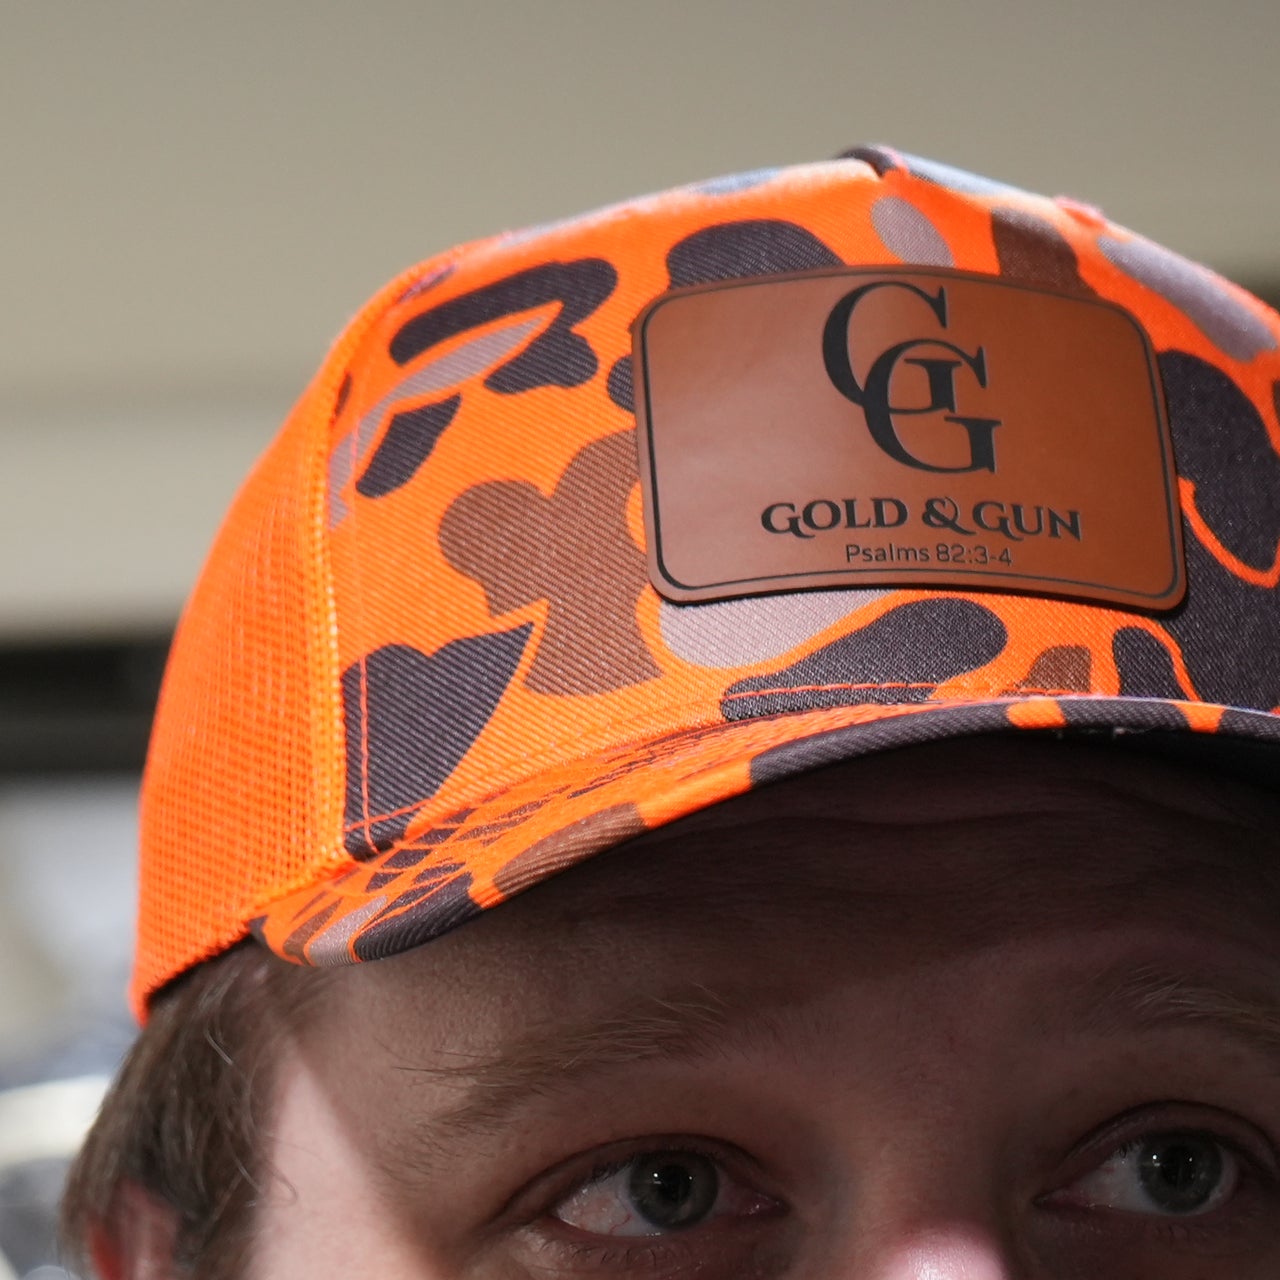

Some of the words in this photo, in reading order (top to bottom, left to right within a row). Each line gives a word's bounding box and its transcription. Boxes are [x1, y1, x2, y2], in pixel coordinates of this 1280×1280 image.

[761, 498, 908, 538] GOLD
[921, 497, 976, 535] &
[973, 500, 1082, 541] GUN
[846, 543, 930, 564] Psalms
[937, 544, 1012, 567] 82:3-4
